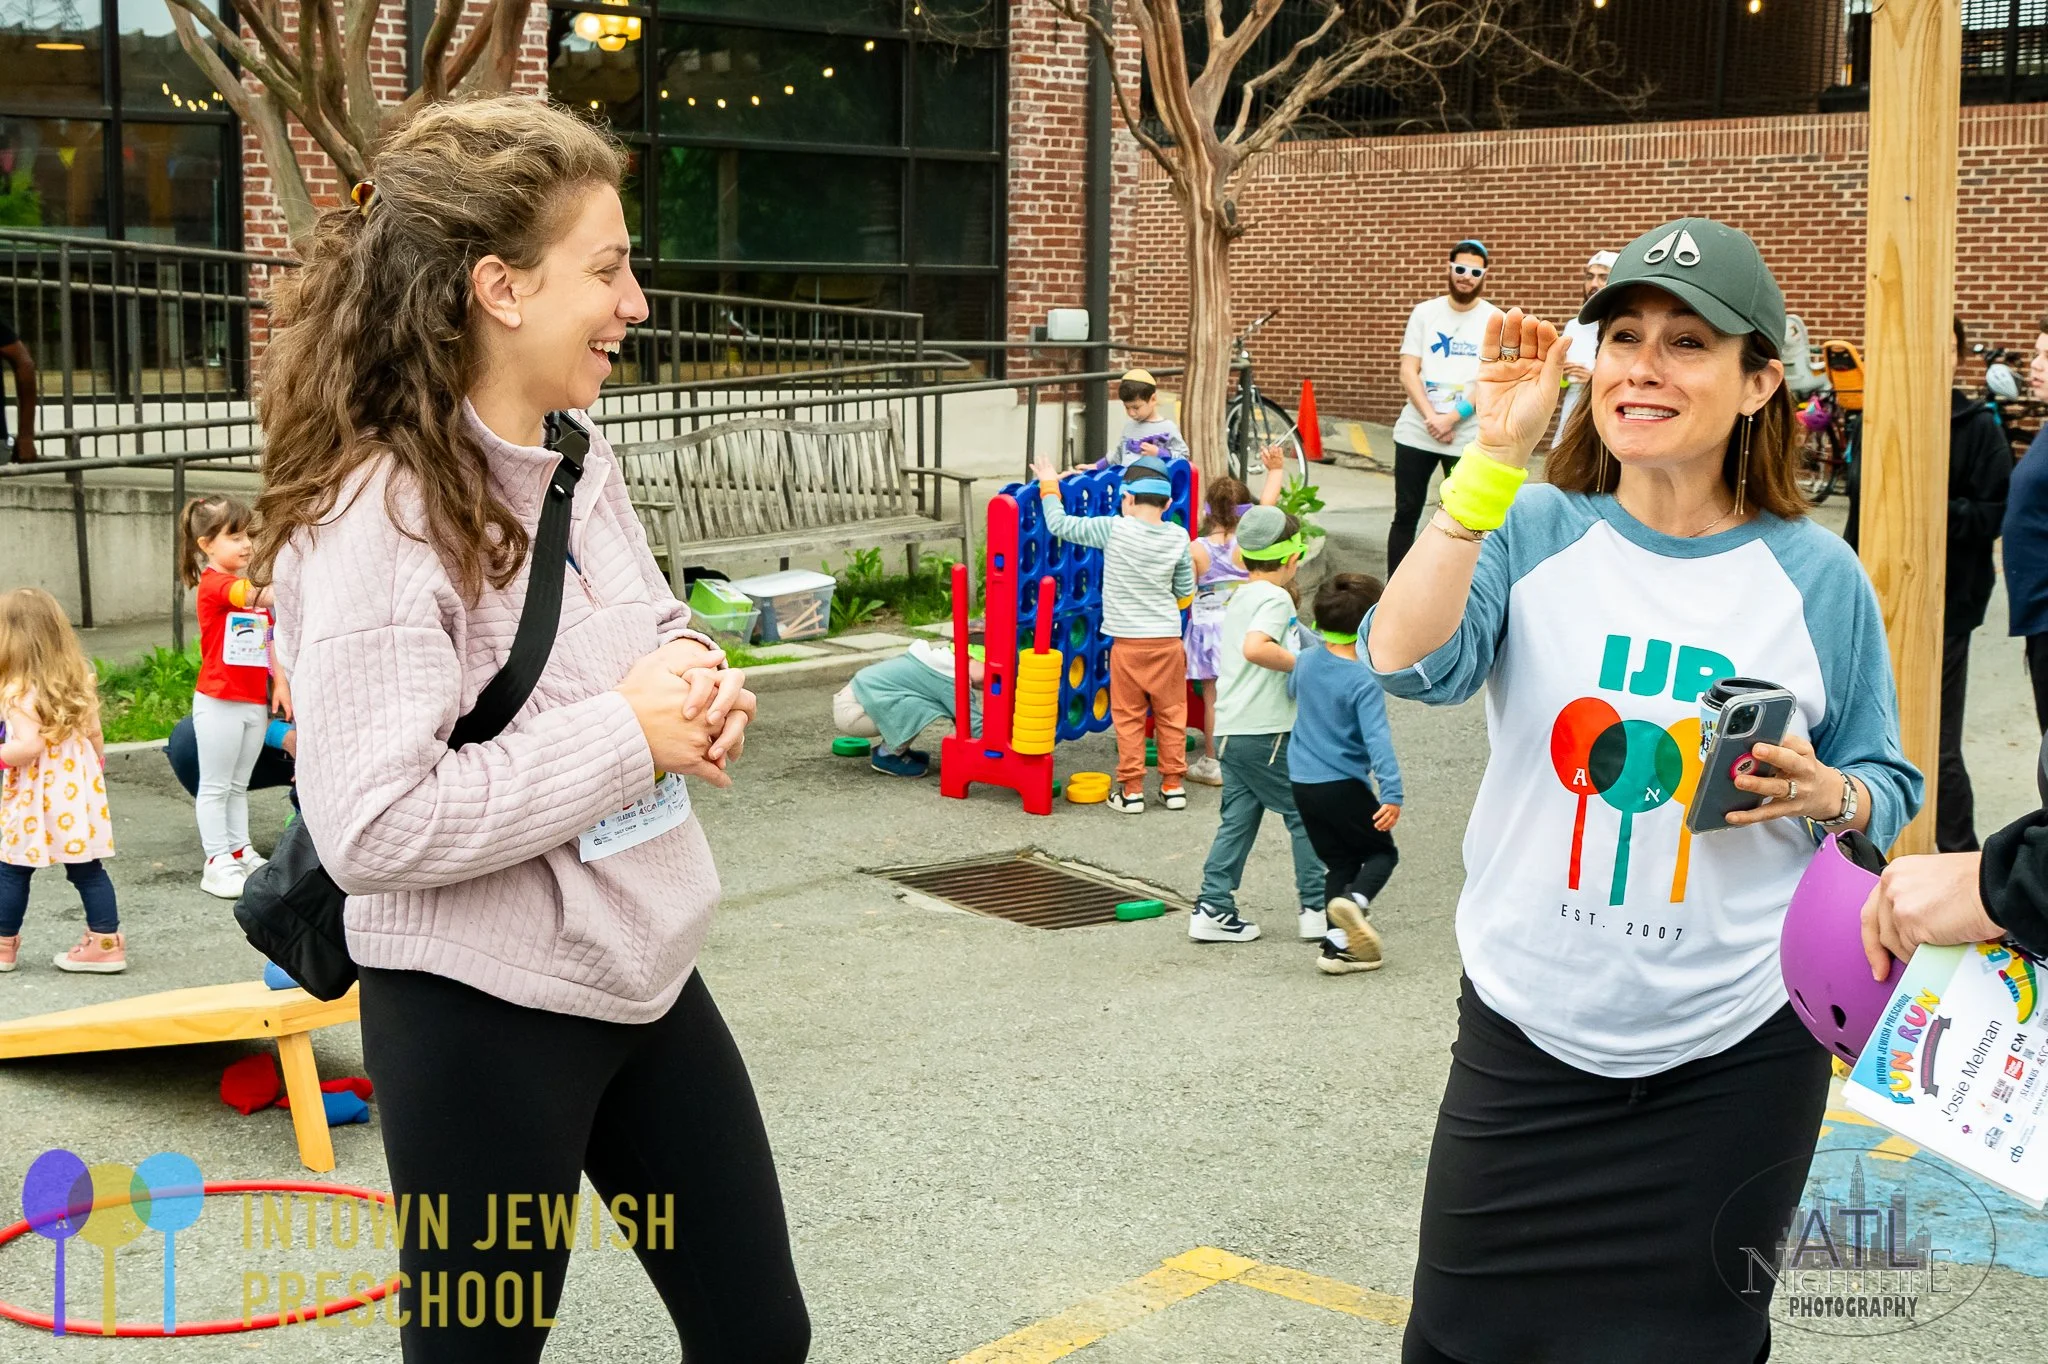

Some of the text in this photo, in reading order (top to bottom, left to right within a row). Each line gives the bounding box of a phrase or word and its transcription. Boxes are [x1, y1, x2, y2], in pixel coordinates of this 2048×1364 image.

[1598, 634, 1736, 703] IJP
[1572, 768, 1588, 786] A
[1645, 786, 1661, 803] א
[1561, 904, 1683, 941] EST. 2007
[1876, 993, 1913, 1085] INTOWN JEWISH PRESCHOOL
[1897, 987, 1941, 1044] RUN
[2010, 1032, 2028, 1053] CM
[1888, 1048, 1915, 1105] FUN
[1941, 1020, 2002, 1122] Josie Melman
[2009, 1145, 2024, 1163] ctb
